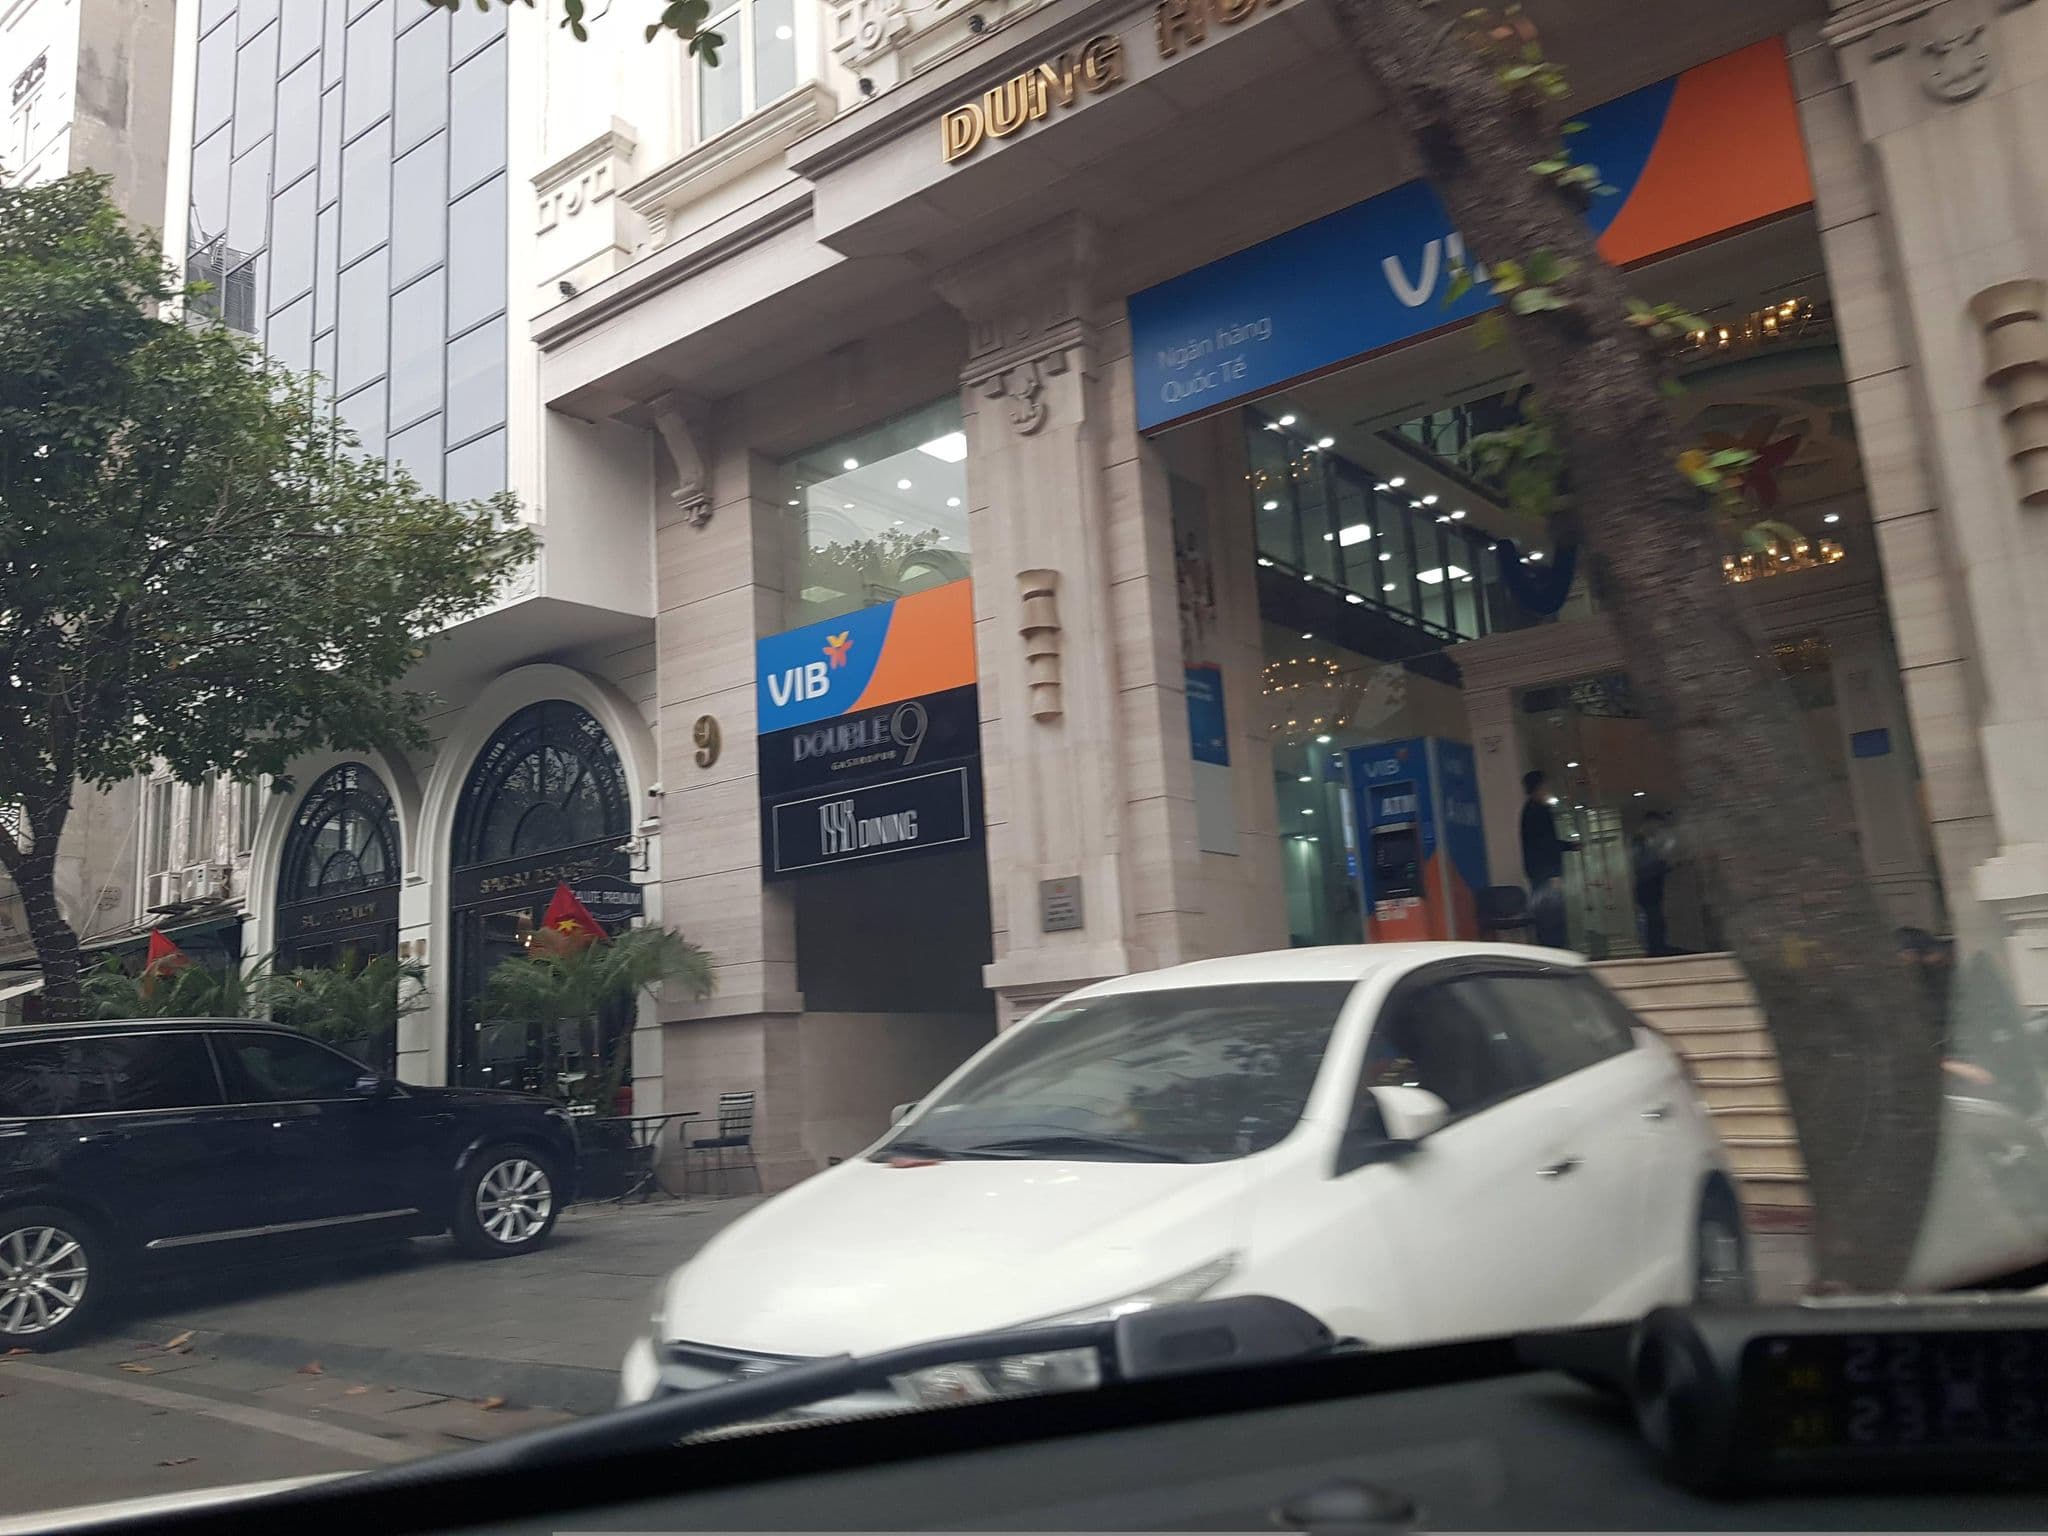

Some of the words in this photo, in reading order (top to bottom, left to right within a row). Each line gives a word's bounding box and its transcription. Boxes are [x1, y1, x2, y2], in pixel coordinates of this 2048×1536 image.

[1381, 232, 1490, 307] VI
[1157, 338, 1213, 370] Ngân
[1216, 317, 1272, 349] hàng
[1161, 368, 1218, 403] Quốc
[767, 661, 830, 707] VIB
[693, 714, 722, 769] 9
[567, 889, 602, 904] ALUTE
